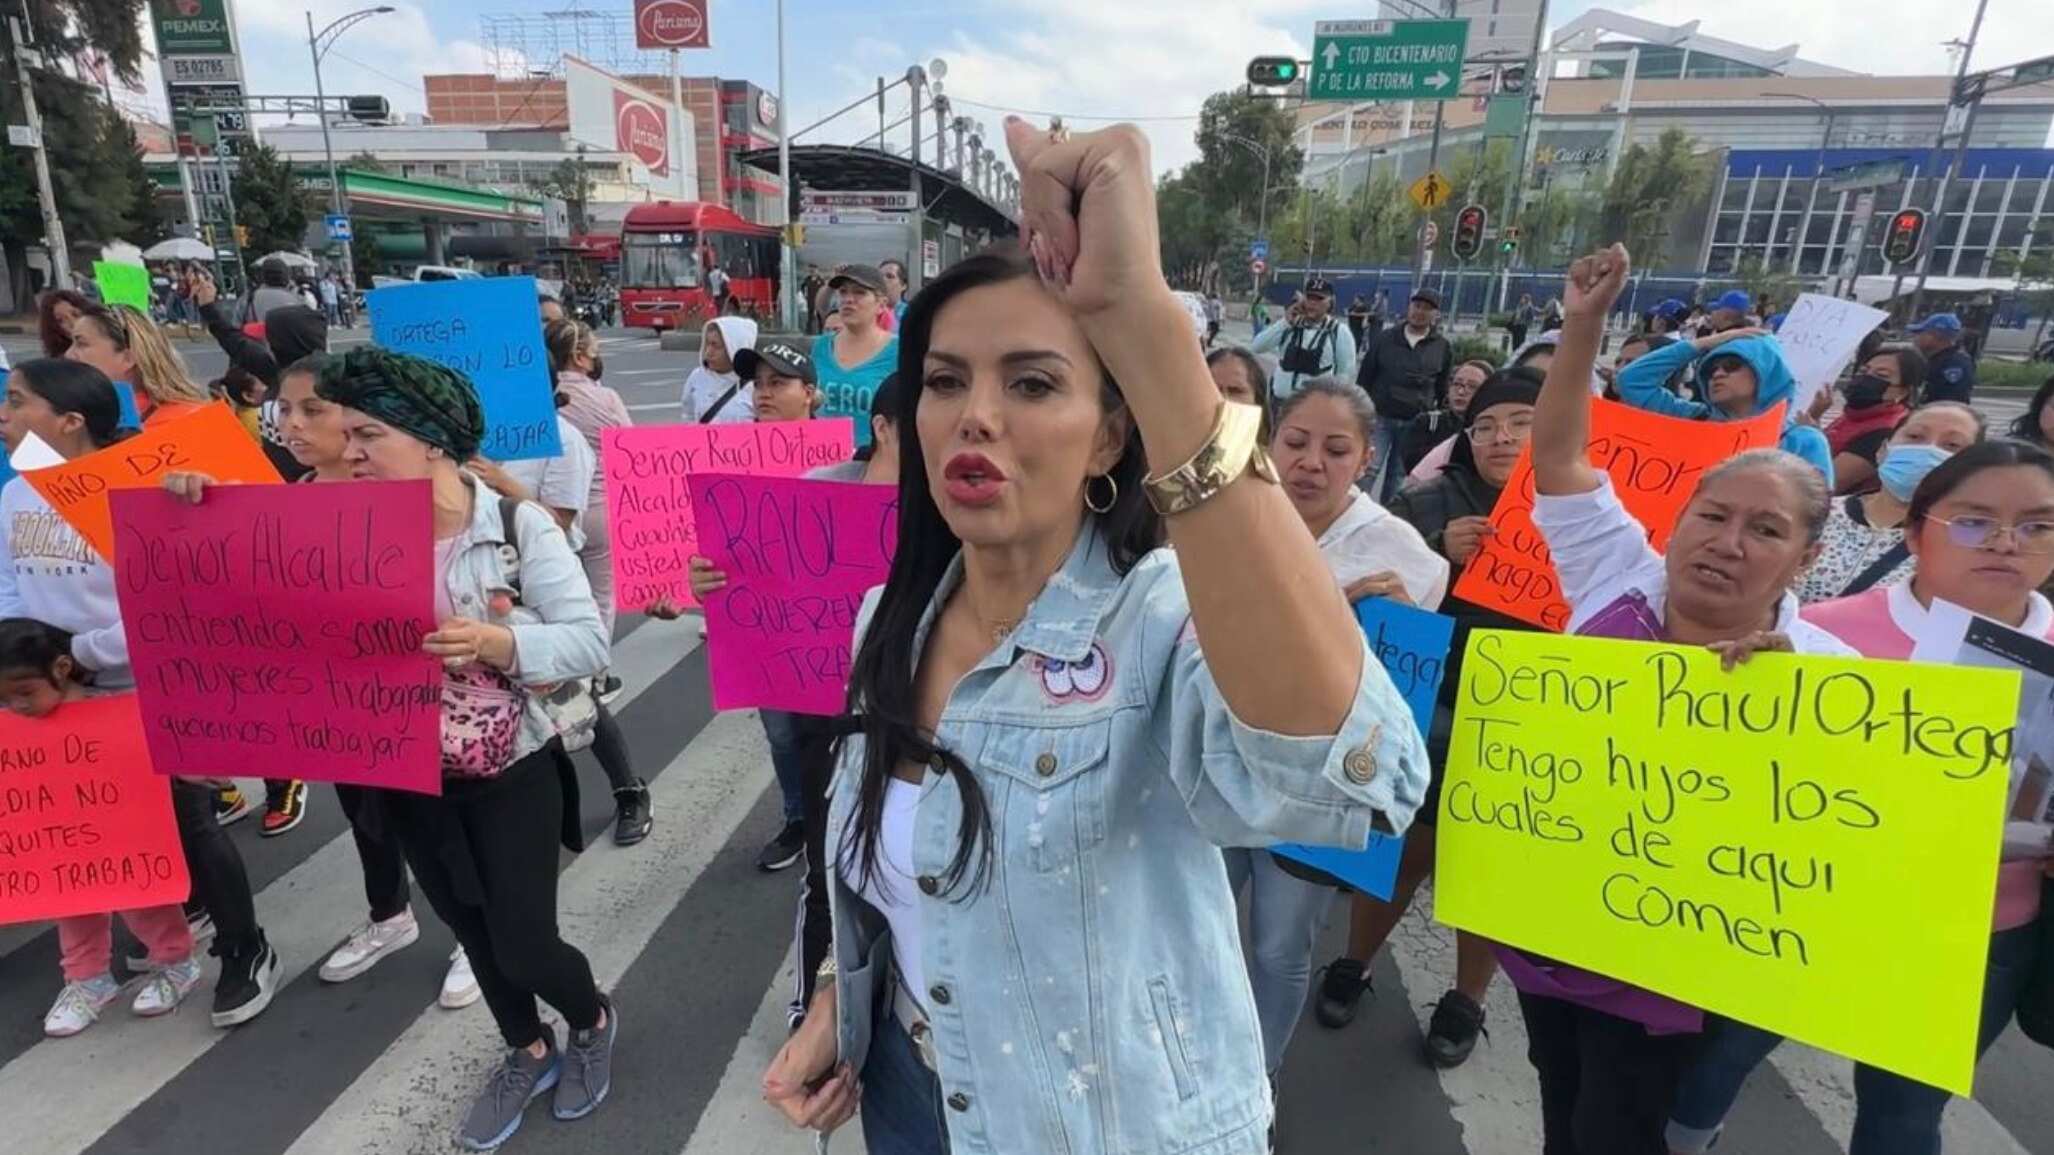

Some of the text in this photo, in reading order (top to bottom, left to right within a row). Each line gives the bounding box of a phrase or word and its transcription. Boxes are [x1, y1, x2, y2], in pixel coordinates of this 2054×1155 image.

[162, 20, 220, 34] PEMEX
[1348, 43, 1458, 65] CTO BICENTENARIO
[1317, 71, 1414, 91] P DE LA REFORMA
[125, 442, 190, 477] DE
[613, 431, 699, 481] Señor
[617, 475, 691, 518] Alcald
[125, 504, 406, 594] Señor Alcalde
[704, 478, 878, 582] RAUL
[619, 547, 683, 578] usted
[156, 655, 315, 715] mujeres
[1469, 634, 2016, 780] Señor Raul Ortega
[0, 732, 102, 773] RNO DE
[286, 706, 419, 770] trabajar
[1465, 716, 1881, 830] Tengo hijos los
[0, 778, 120, 819] DIA NO
[52, 852, 173, 895] TRABAJO
[1610, 813, 1675, 869] de
[1707, 842, 1834, 914] aqui
